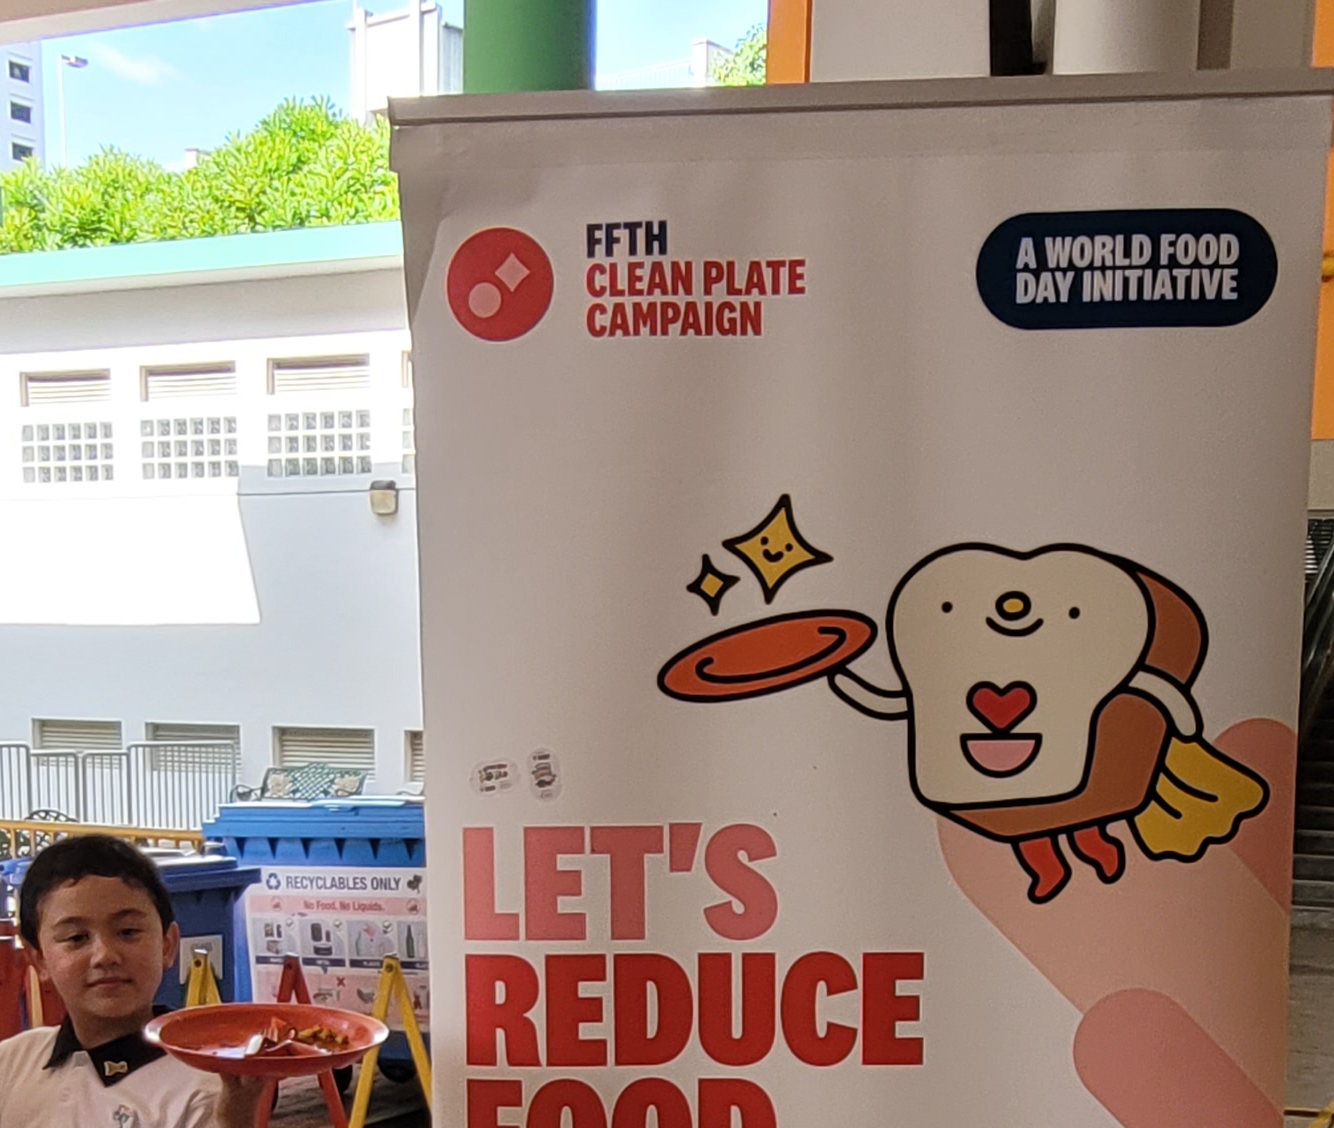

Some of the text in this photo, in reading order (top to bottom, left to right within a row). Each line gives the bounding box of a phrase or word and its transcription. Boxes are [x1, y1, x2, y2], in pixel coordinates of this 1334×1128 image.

[586, 220, 667, 259] FFTH
[1016, 234, 1239, 268] A WORLD FOOD
[586, 259, 807, 298] CLEAN PLATE
[1016, 269, 1238, 305] DAY INITIATIVE
[586, 301, 763, 338] CAMPAIGN
[286, 876, 401, 890] RECYCLABLES ONLY
[463, 823, 778, 941] LET'S
[465, 952, 924, 1067] REDUCE
